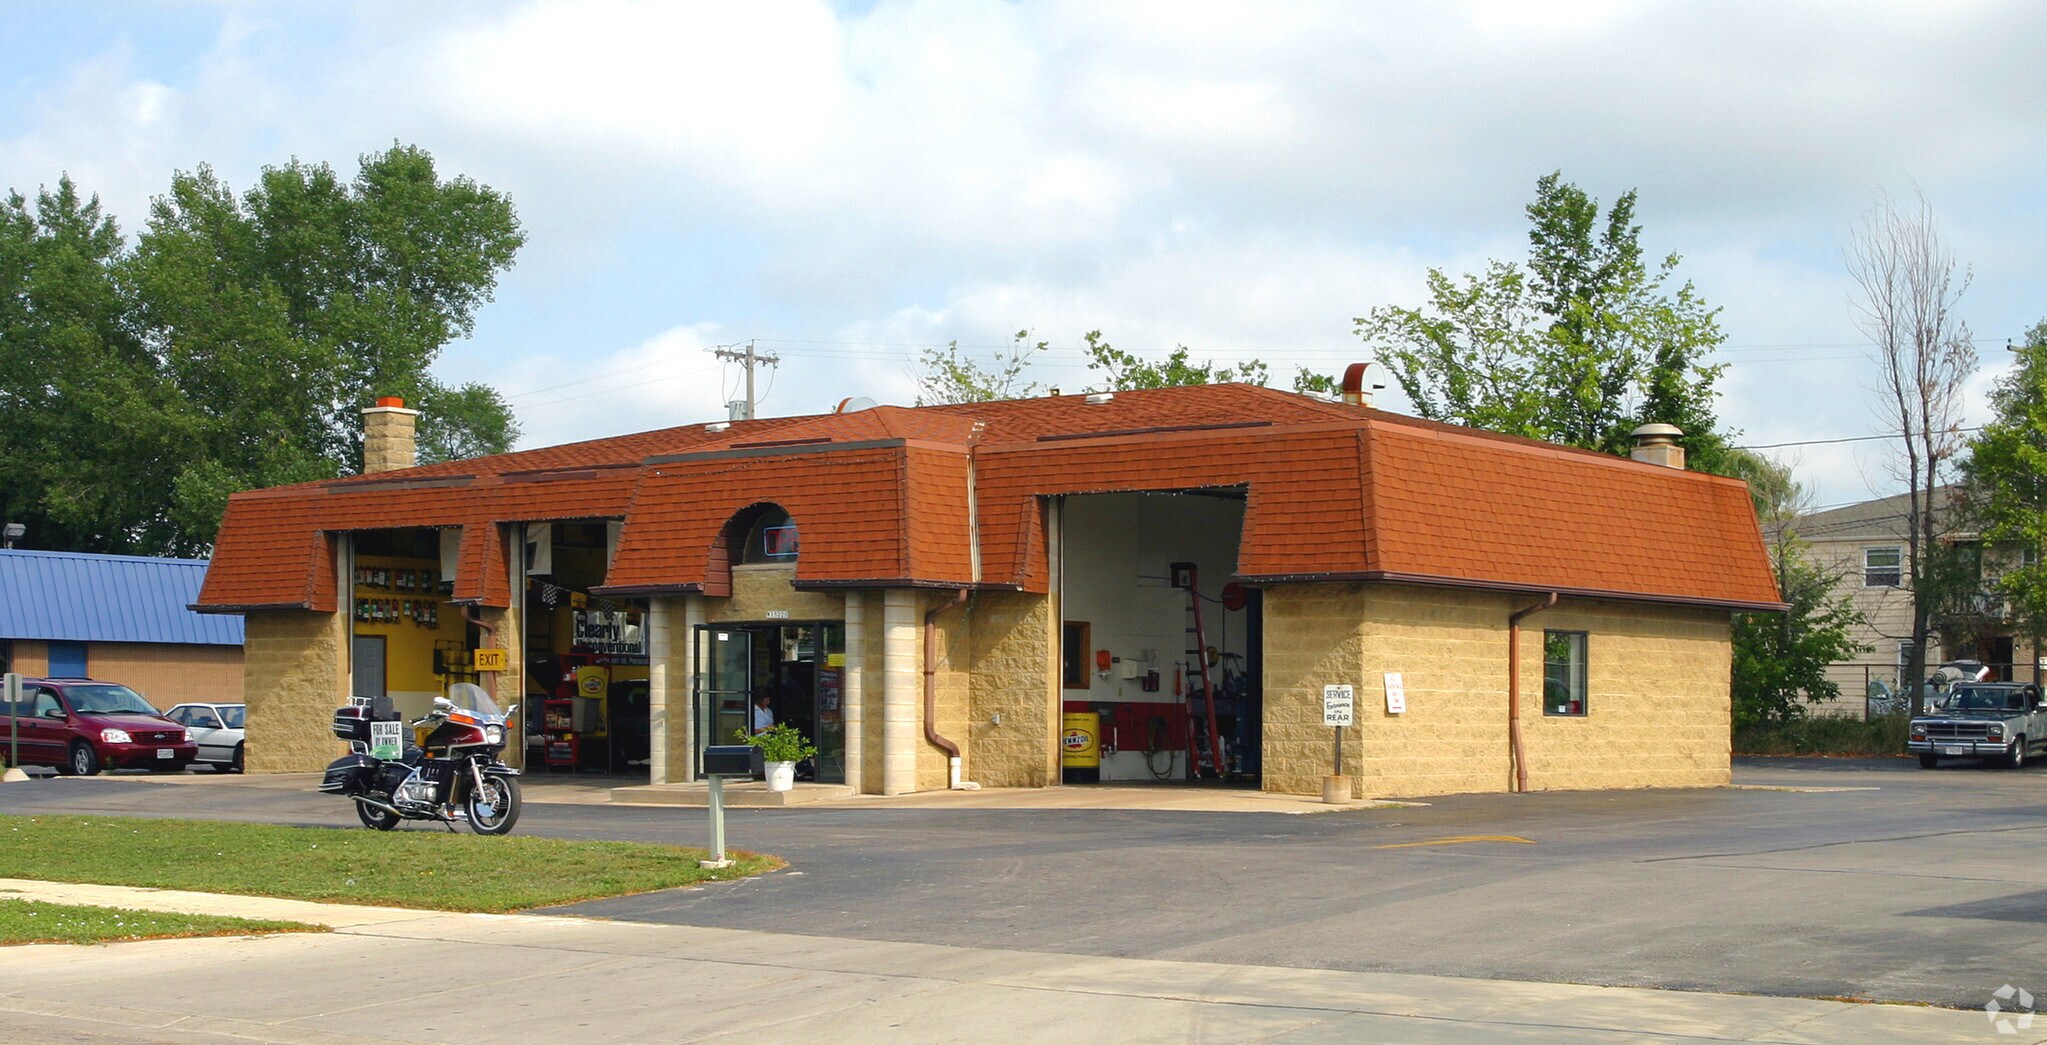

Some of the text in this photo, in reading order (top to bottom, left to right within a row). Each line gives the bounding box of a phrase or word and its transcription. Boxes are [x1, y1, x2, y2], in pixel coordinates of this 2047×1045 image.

[576, 621, 619, 641] Clearly
[479, 653, 499, 666] EXIT
[1326, 690, 1351, 699] SERVICE
[373, 723, 399, 735] FOR SALE
[382, 736, 397, 746] OWNER
